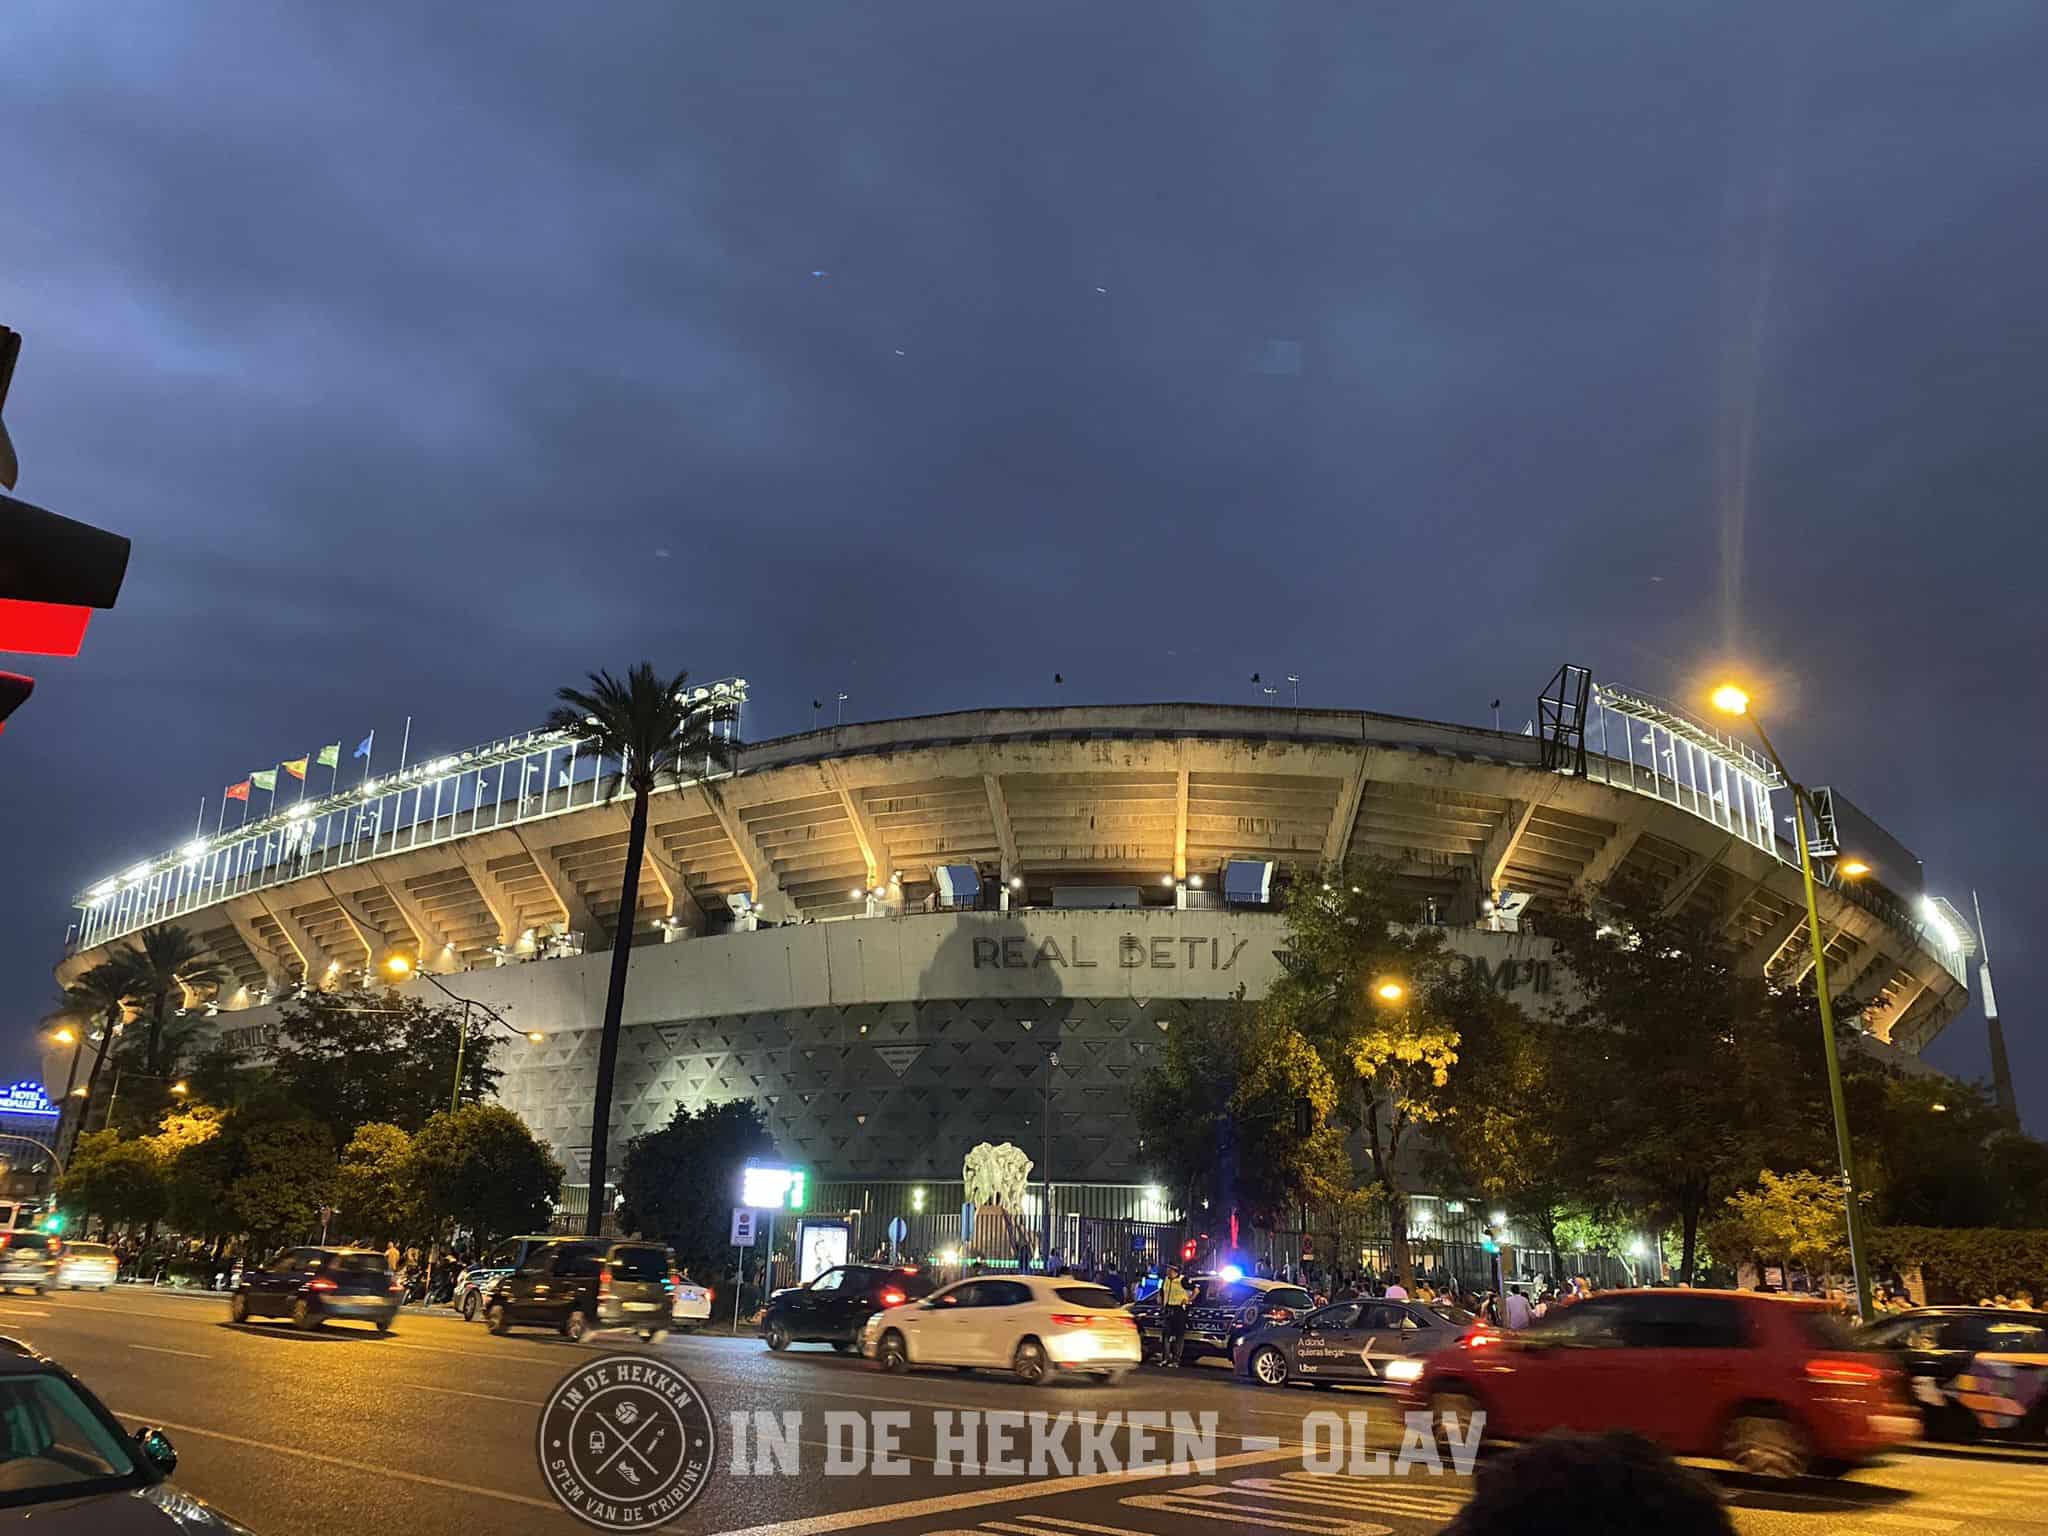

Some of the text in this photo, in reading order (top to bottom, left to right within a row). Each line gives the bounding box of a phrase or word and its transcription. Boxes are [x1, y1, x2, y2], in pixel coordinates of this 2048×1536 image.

[972, 935, 1097, 969] REAL
[1118, 935, 1249, 970] BETIS
[1299, 1363, 1319, 1373] Uber
